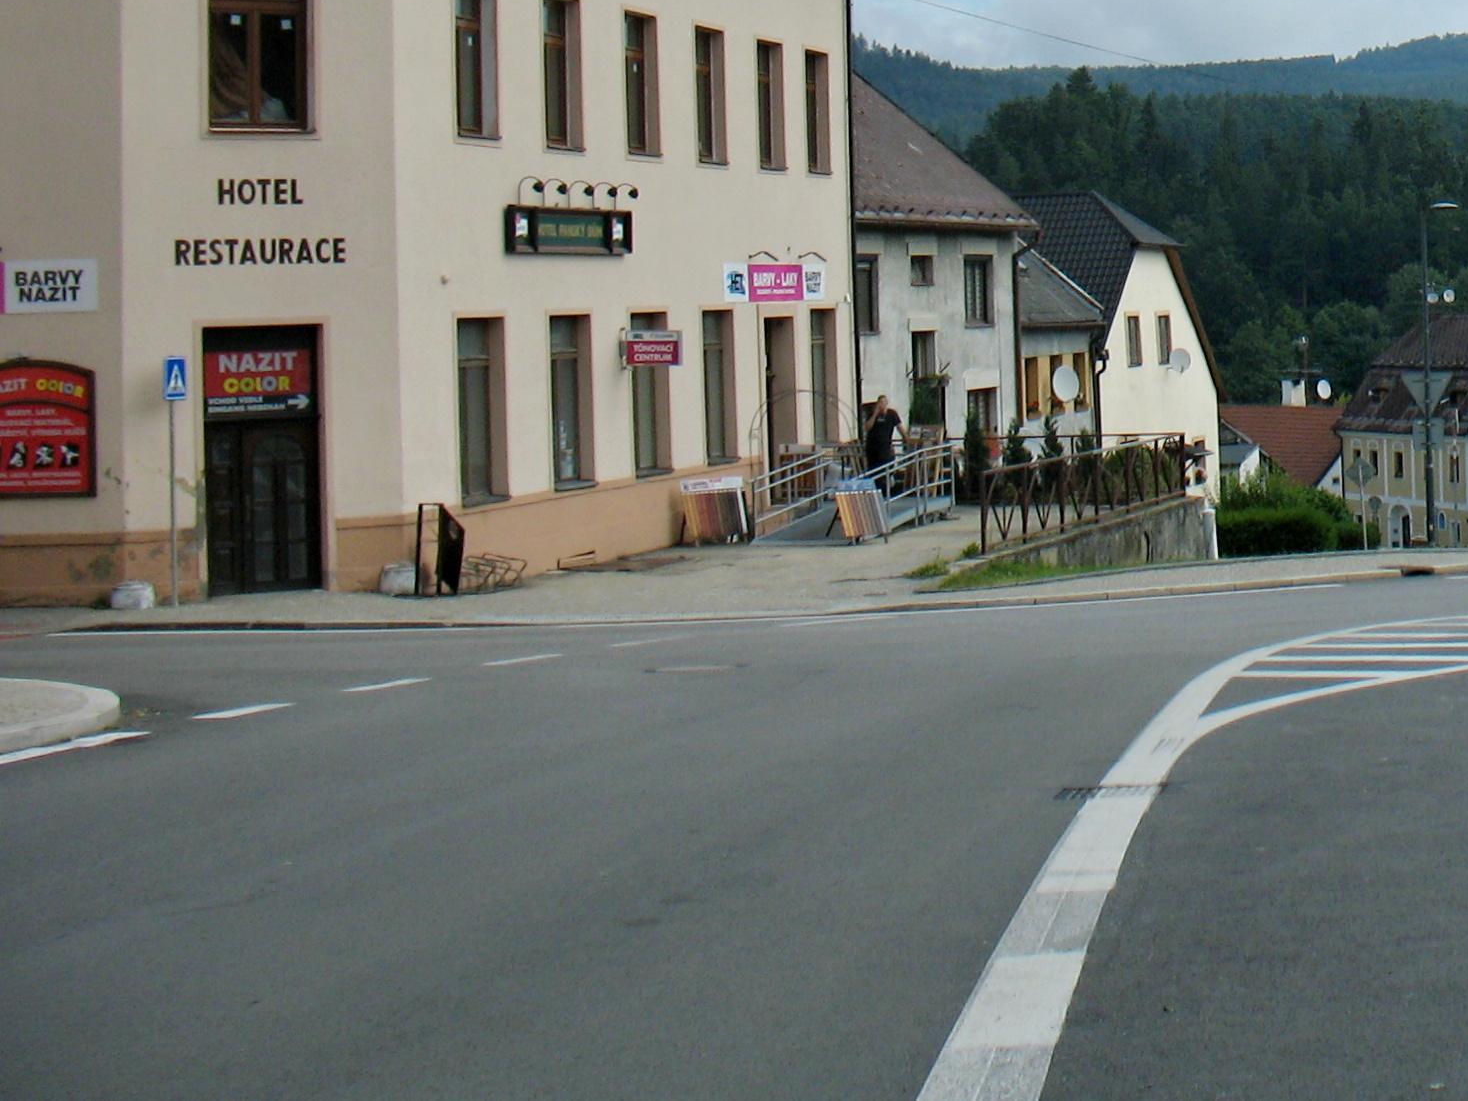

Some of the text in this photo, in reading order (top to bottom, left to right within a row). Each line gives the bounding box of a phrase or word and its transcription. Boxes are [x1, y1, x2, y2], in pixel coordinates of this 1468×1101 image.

[217, 179, 303, 205] HOTEL
[174, 238, 346, 266] RESTAURACE
[15, 270, 83, 286] BARVY
[753, 272, 775, 287] BARVY
[781, 272, 799, 287] LAKY
[18, 286, 81, 302] NAZIT
[218, 351, 298, 373] NAZIT
[634, 353, 673, 362] CENTRUM
[0, 378, 84, 398] ZIT COLOR
[223, 376, 291, 393] COLOR
